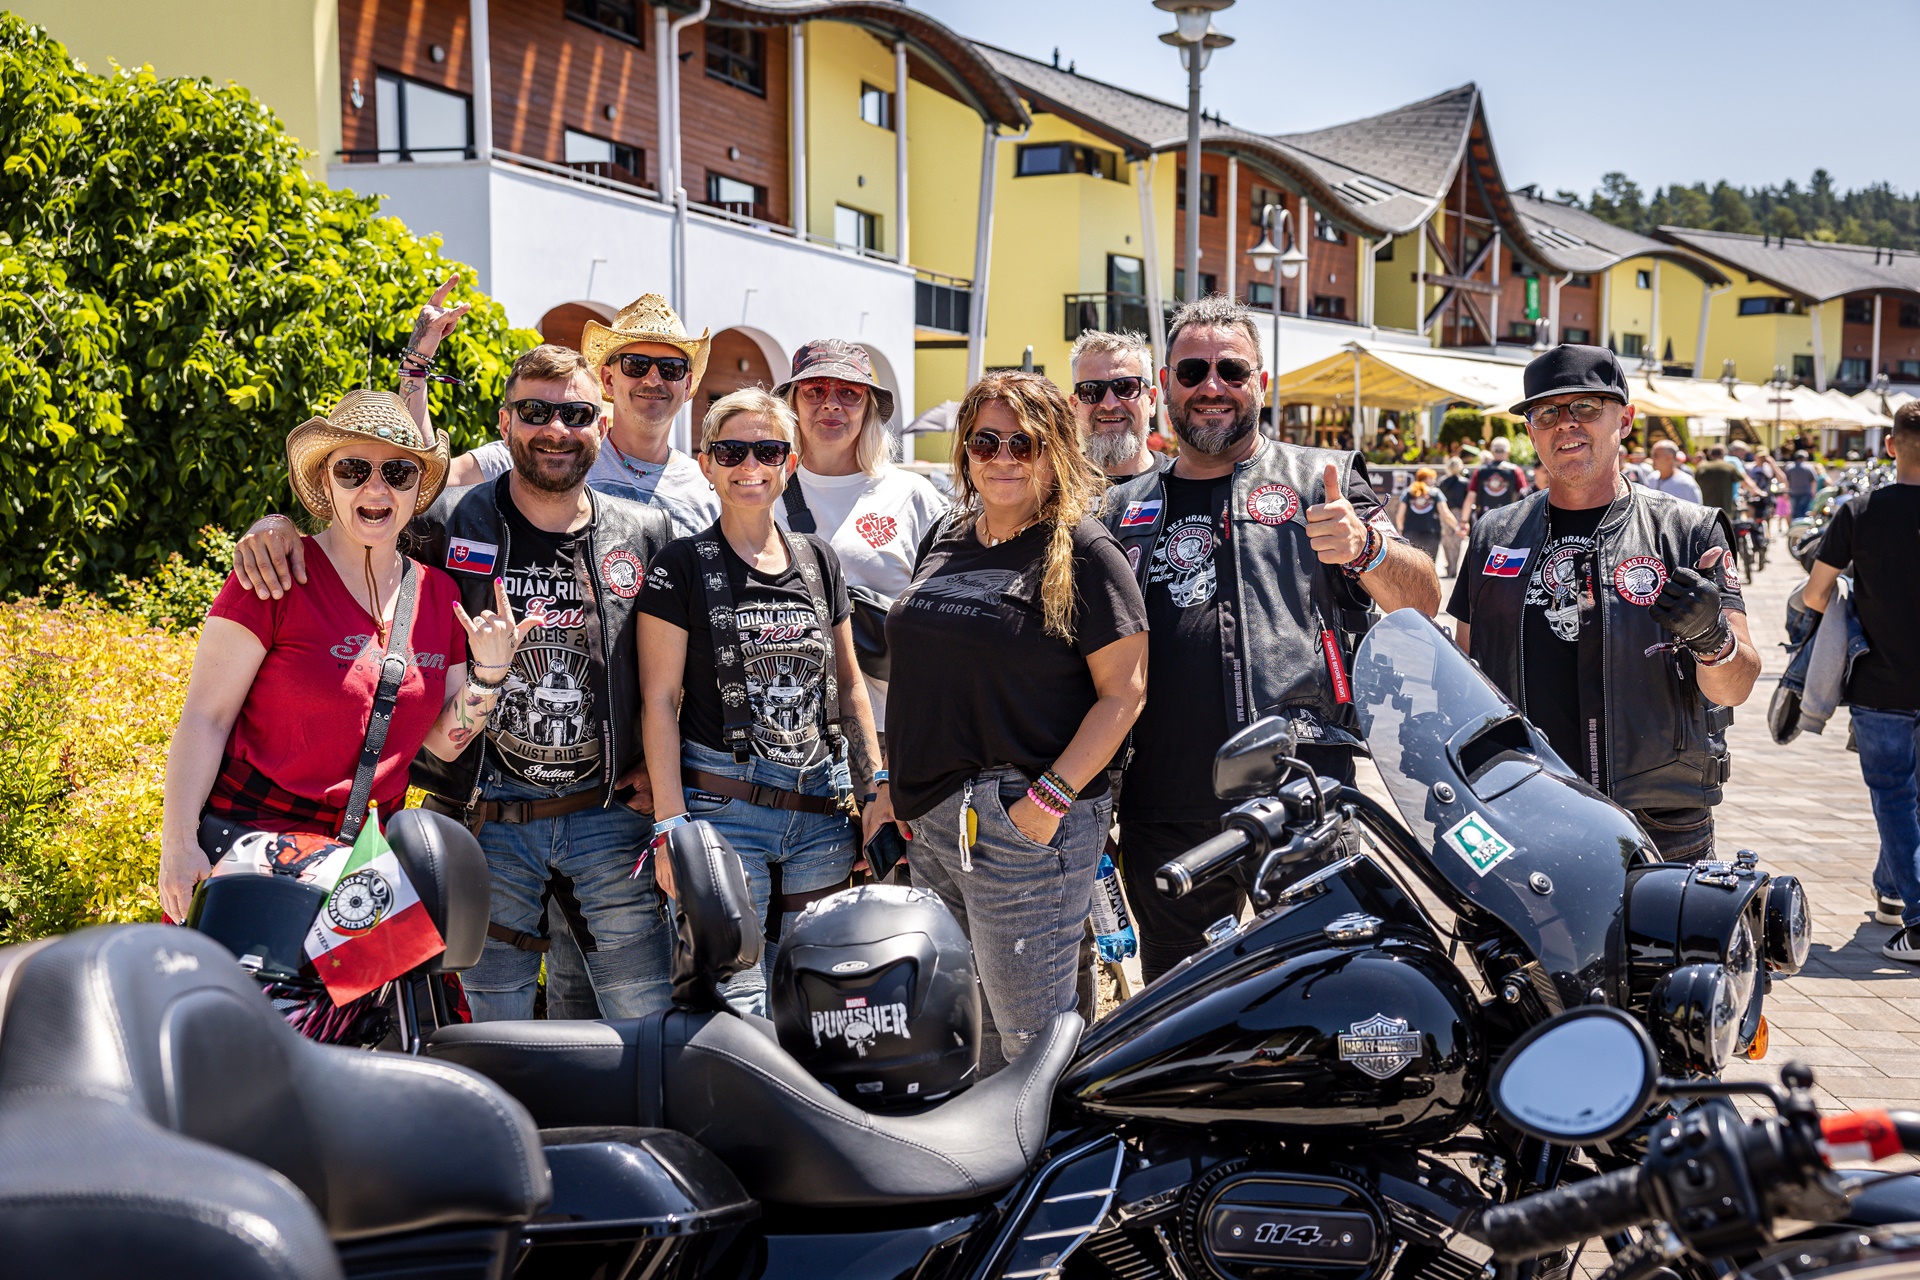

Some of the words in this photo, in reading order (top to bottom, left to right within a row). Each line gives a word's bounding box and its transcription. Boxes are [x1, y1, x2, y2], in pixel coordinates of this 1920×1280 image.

[1248, 490, 1261, 512] INDIAN
[1260, 485, 1297, 511] MOTORCYCLE
[855, 512, 879, 526] ONE
[1166, 518, 1185, 533] BEZ
[1259, 514, 1288, 524] RIDERS
[866, 522, 898, 550] HEART
[1169, 538, 1180, 561] INDIAN
[1177, 528, 1211, 546] MOTORCYCLE
[603, 562, 617, 587] INDIAN
[1543, 563, 1555, 586] INDIAN
[1615, 565, 1627, 593] INDIAN
[503, 576, 550, 598] DIAN
[525, 596, 585, 628] Fest
[900, 596, 935, 611] DARK
[937, 603, 982, 617] HORSE
[777, 610, 819, 626] RIDER
[755, 622, 807, 646] Fest
[329, 633, 446, 671] Inian
[1326, 640, 1338, 662] REMOVE
[1331, 660, 1342, 680] BEFORE
[1337, 679, 1347, 699] FLIGHT
[758, 730, 784, 744] JUST
[787, 730, 809, 744] RIDE
[513, 743, 549, 761] JUST
[554, 746, 585, 762] RIDE
[766, 746, 805, 760] Indian
[523, 764, 576, 779] Indian
[328, 877, 355, 911] INDIANS
[333, 913, 377, 930] FRIENDS
[846, 999, 867, 1008] MARVEL
[811, 1002, 911, 1049] PUNISHER
[1360, 1021, 1400, 1037] MOTOR
[1345, 1038, 1417, 1054] HARLEY-DAVIDSON
[1360, 1055, 1400, 1071] CYCLES
[1254, 1222, 1323, 1246] 114
